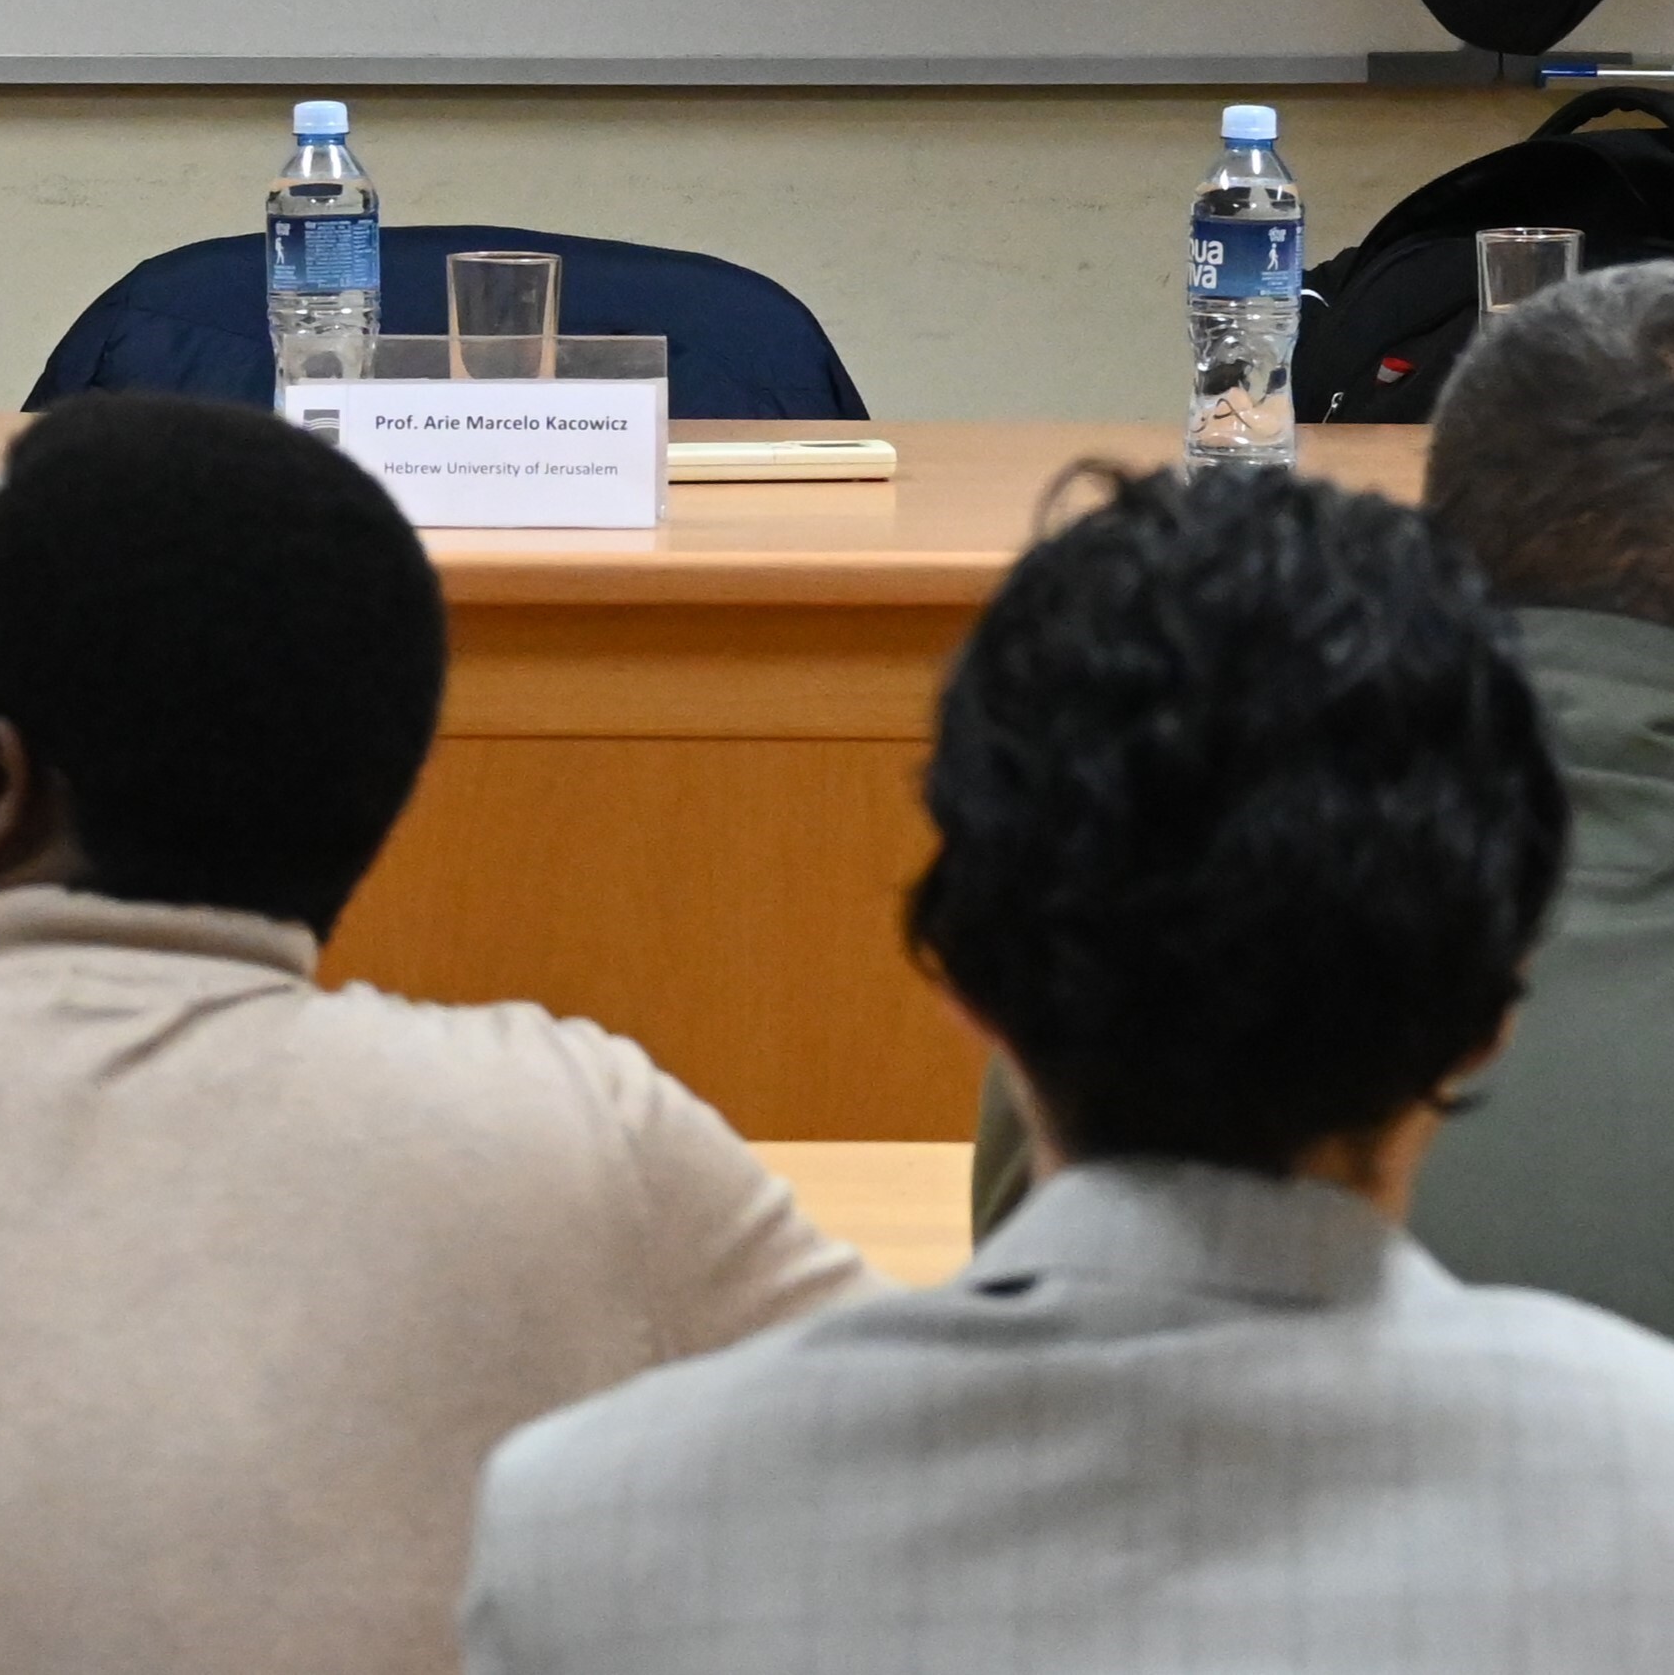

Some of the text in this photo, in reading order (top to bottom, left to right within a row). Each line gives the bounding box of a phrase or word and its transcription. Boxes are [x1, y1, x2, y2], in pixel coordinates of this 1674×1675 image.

[375, 415, 628, 431] Prof. Arie Marcelo Kacowicz
[384, 462, 618, 478] Hebrew University of Jerusalem
